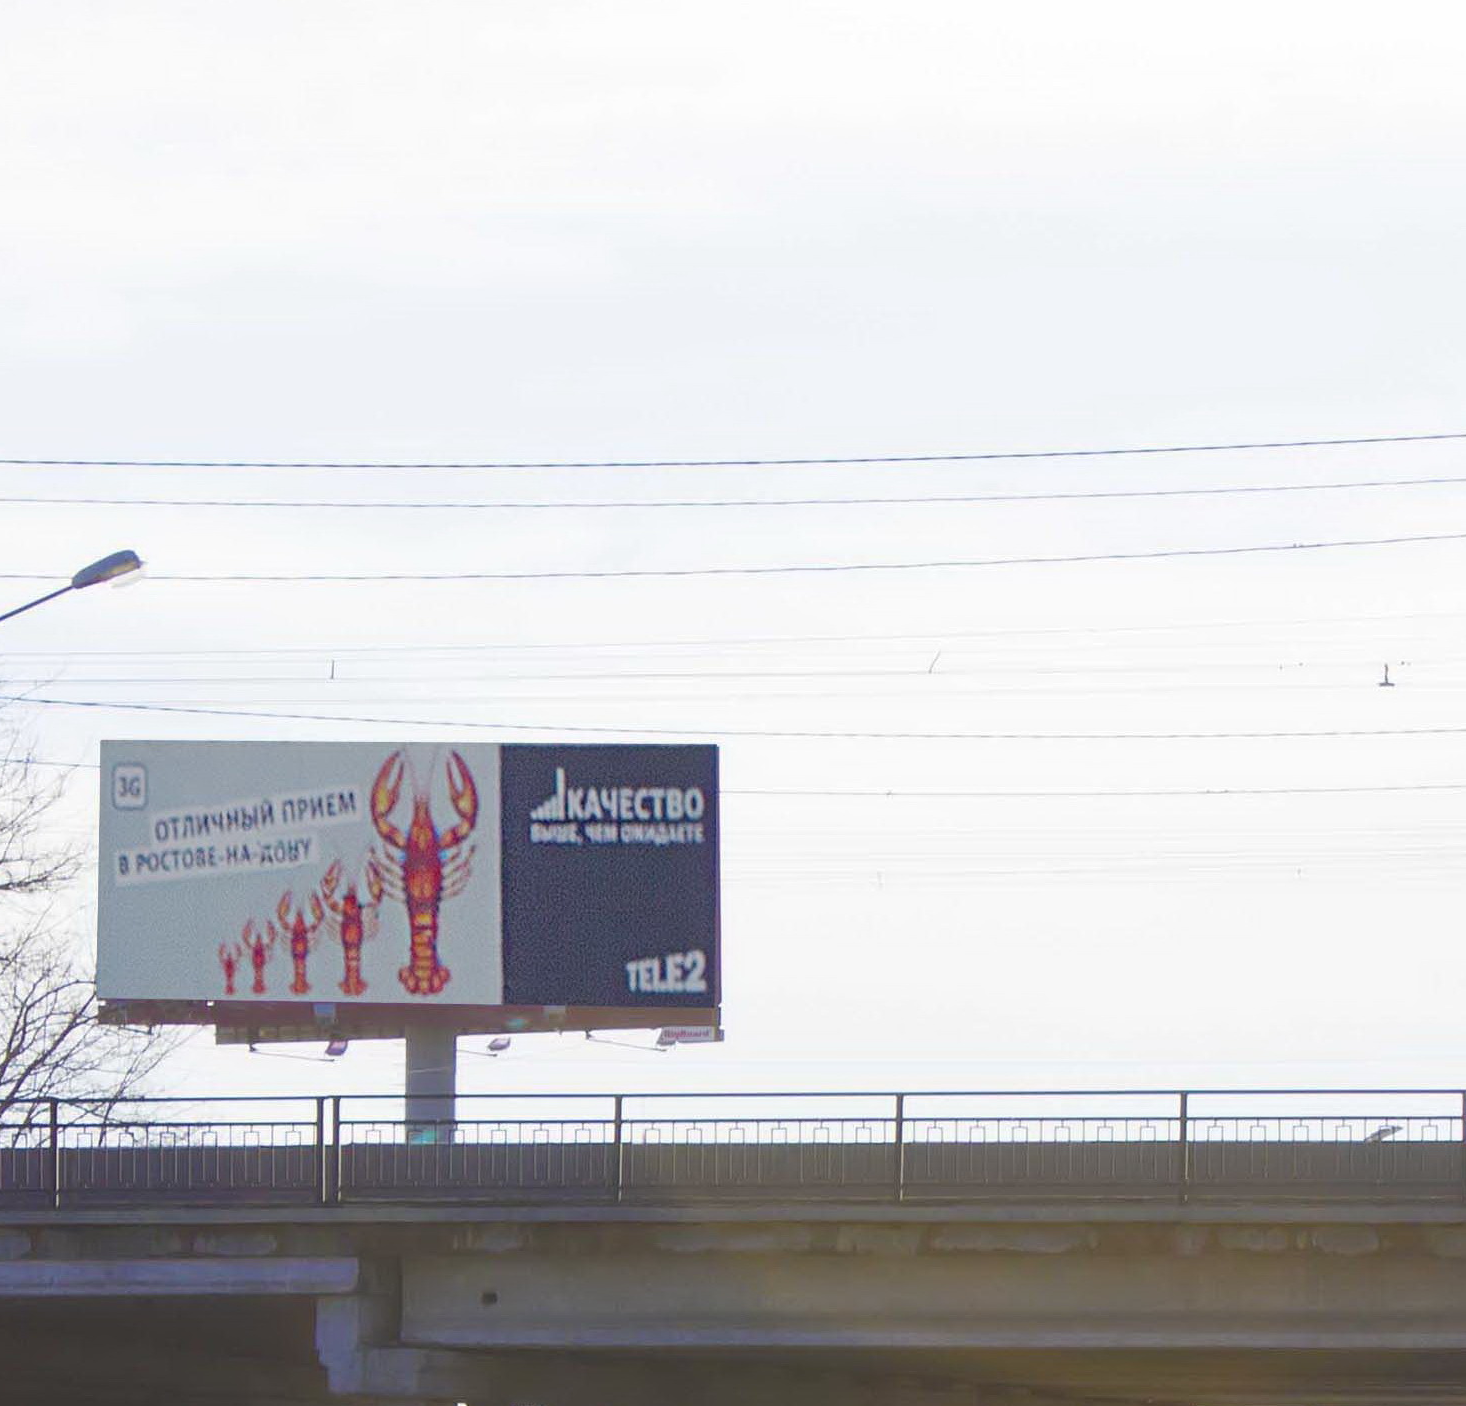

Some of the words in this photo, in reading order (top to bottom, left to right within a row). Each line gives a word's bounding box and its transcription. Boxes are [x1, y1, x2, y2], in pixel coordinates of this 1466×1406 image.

[118, 776, 142, 798] 3G
[566, 786, 705, 821] КАЧЕСТВО
[154, 800, 276, 842] ОТЛИЧНЫЙ
[282, 791, 357, 823] ПРИЕМ
[118, 856, 130, 876] В
[626, 949, 708, 992] TELE2
